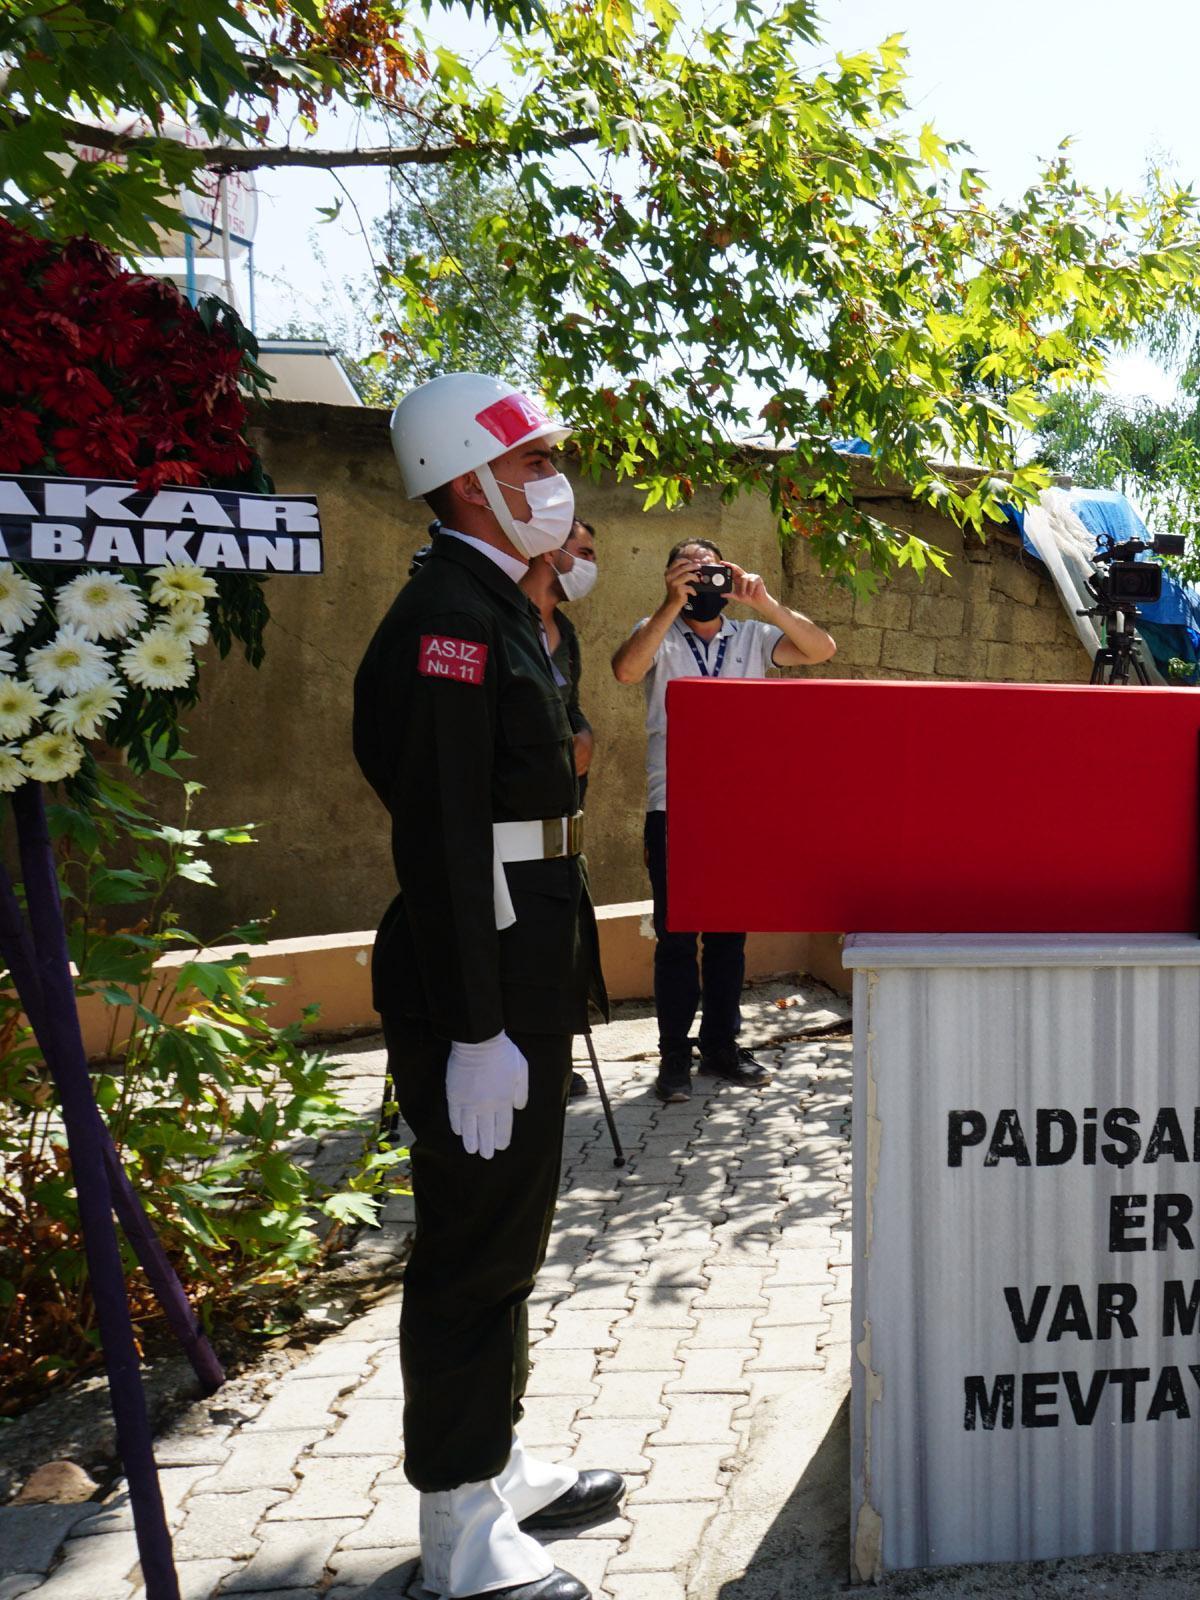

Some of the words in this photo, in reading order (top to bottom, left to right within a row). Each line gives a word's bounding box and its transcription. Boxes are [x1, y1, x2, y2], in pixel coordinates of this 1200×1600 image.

[30, 522, 321, 572] BAKANI
[1108, 1193, 1195, 1252] ER
[1003, 1282, 1138, 1343] VAR
